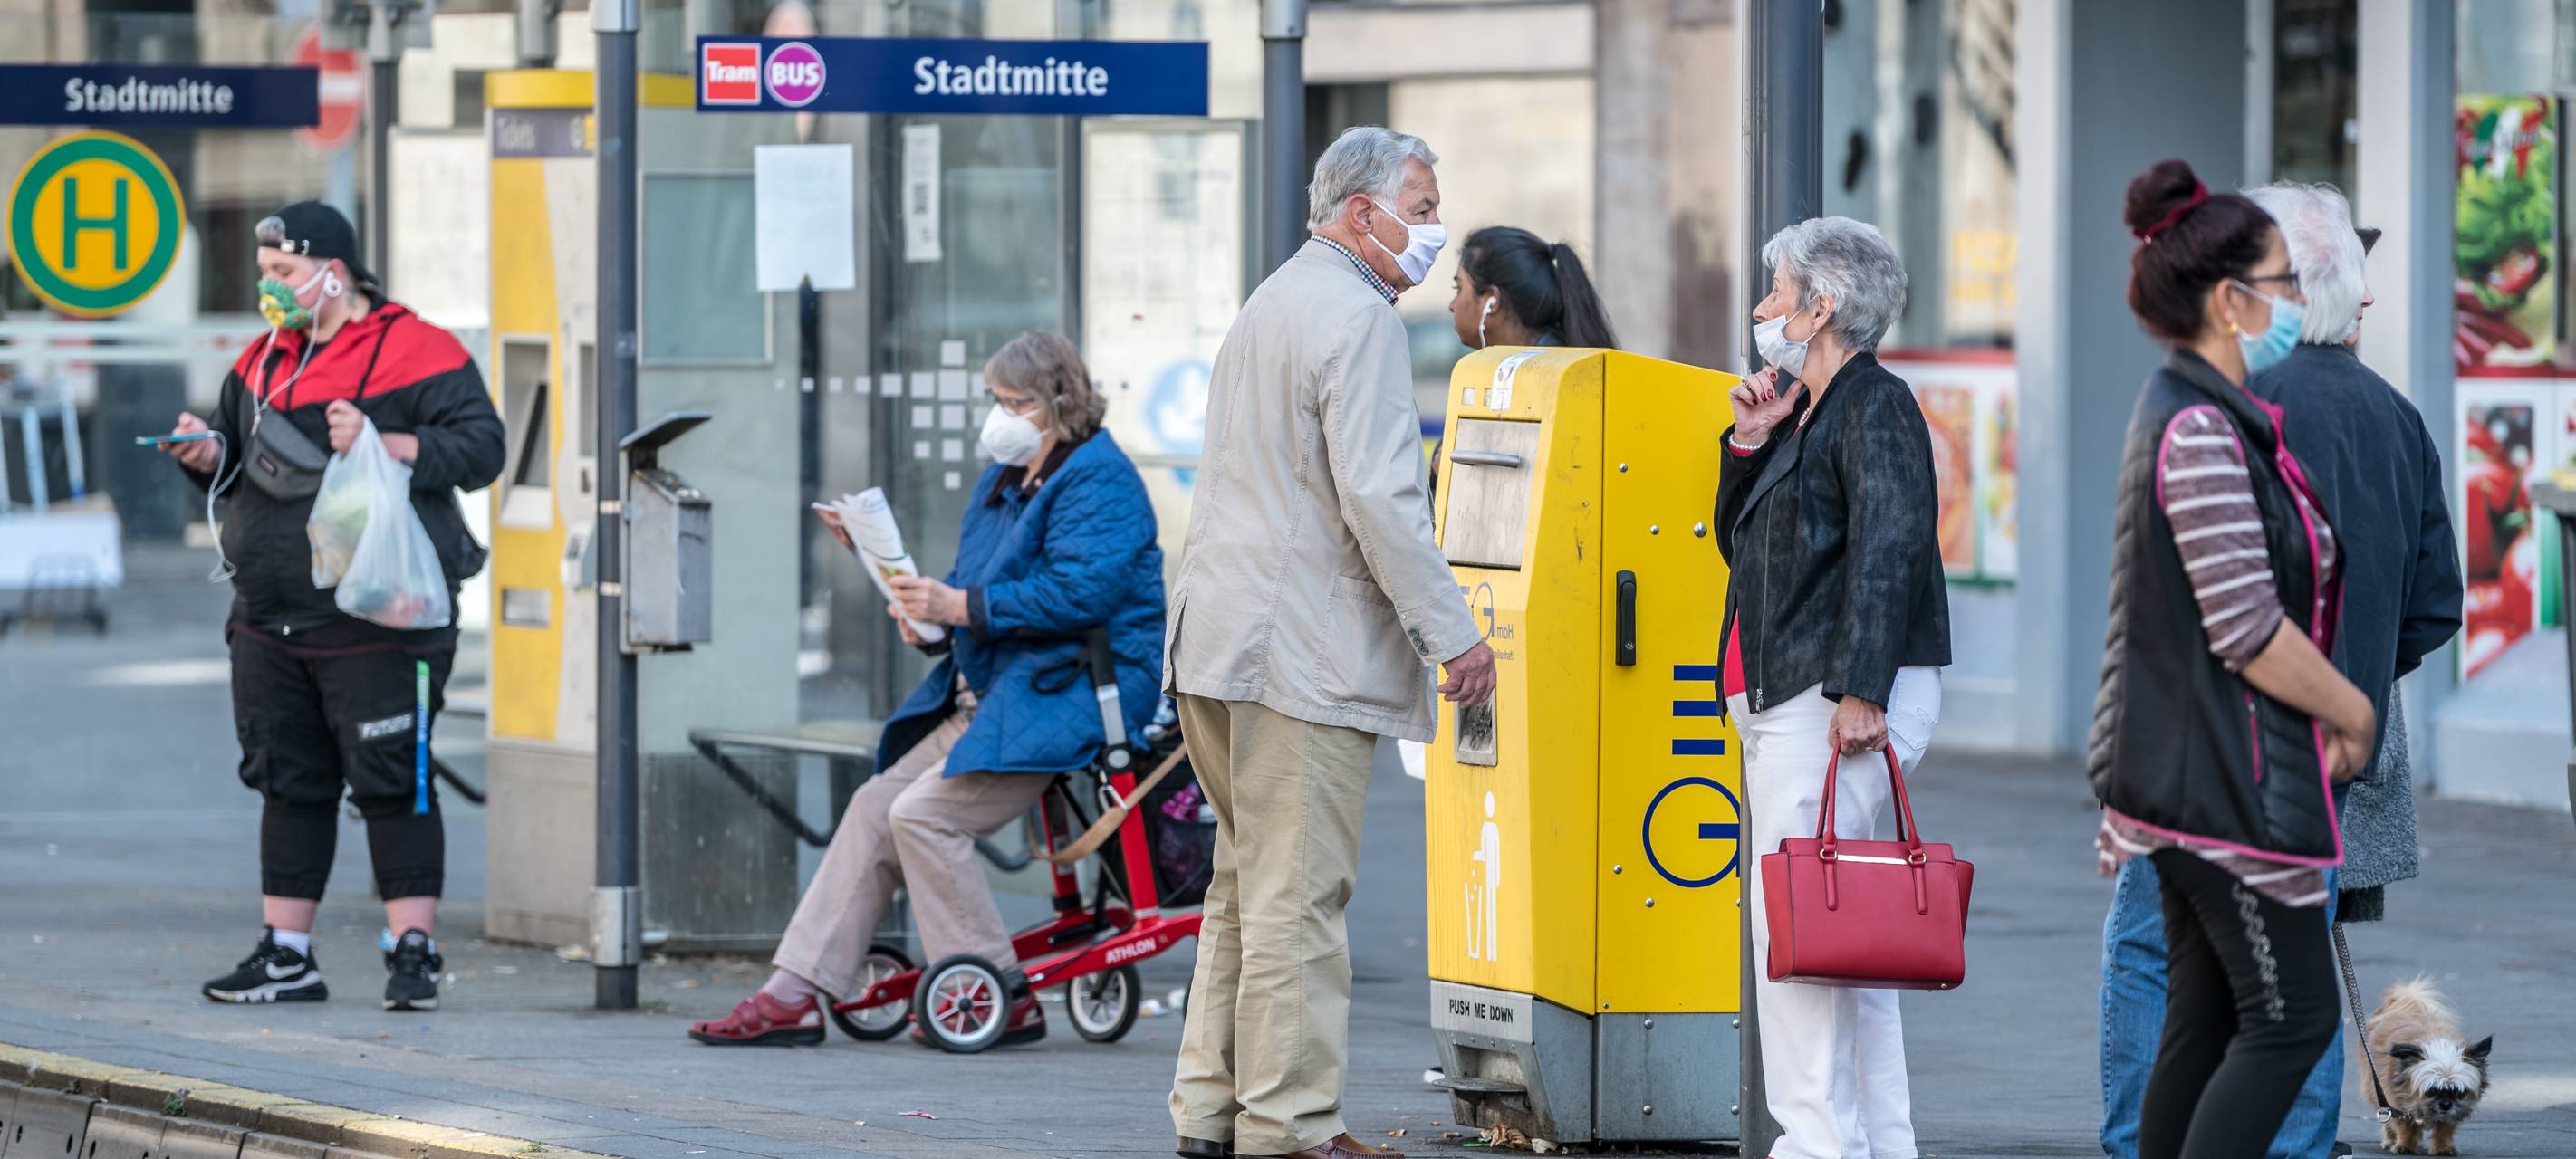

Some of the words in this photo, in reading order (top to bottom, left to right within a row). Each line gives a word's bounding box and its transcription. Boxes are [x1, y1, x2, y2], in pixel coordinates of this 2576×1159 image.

[707, 61, 757, 82] Tram
[771, 62, 820, 87] BUS
[914, 55, 1108, 96] Stadtmitte
[65, 76, 234, 113] Stadtmitte
[63, 177, 129, 271] H
[1106, 936, 1157, 965] ATHLON
[1449, 999, 1470, 1017] PUSH
[1474, 1002, 1485, 1020] ME
[1489, 1005, 1514, 1023] DOWN
